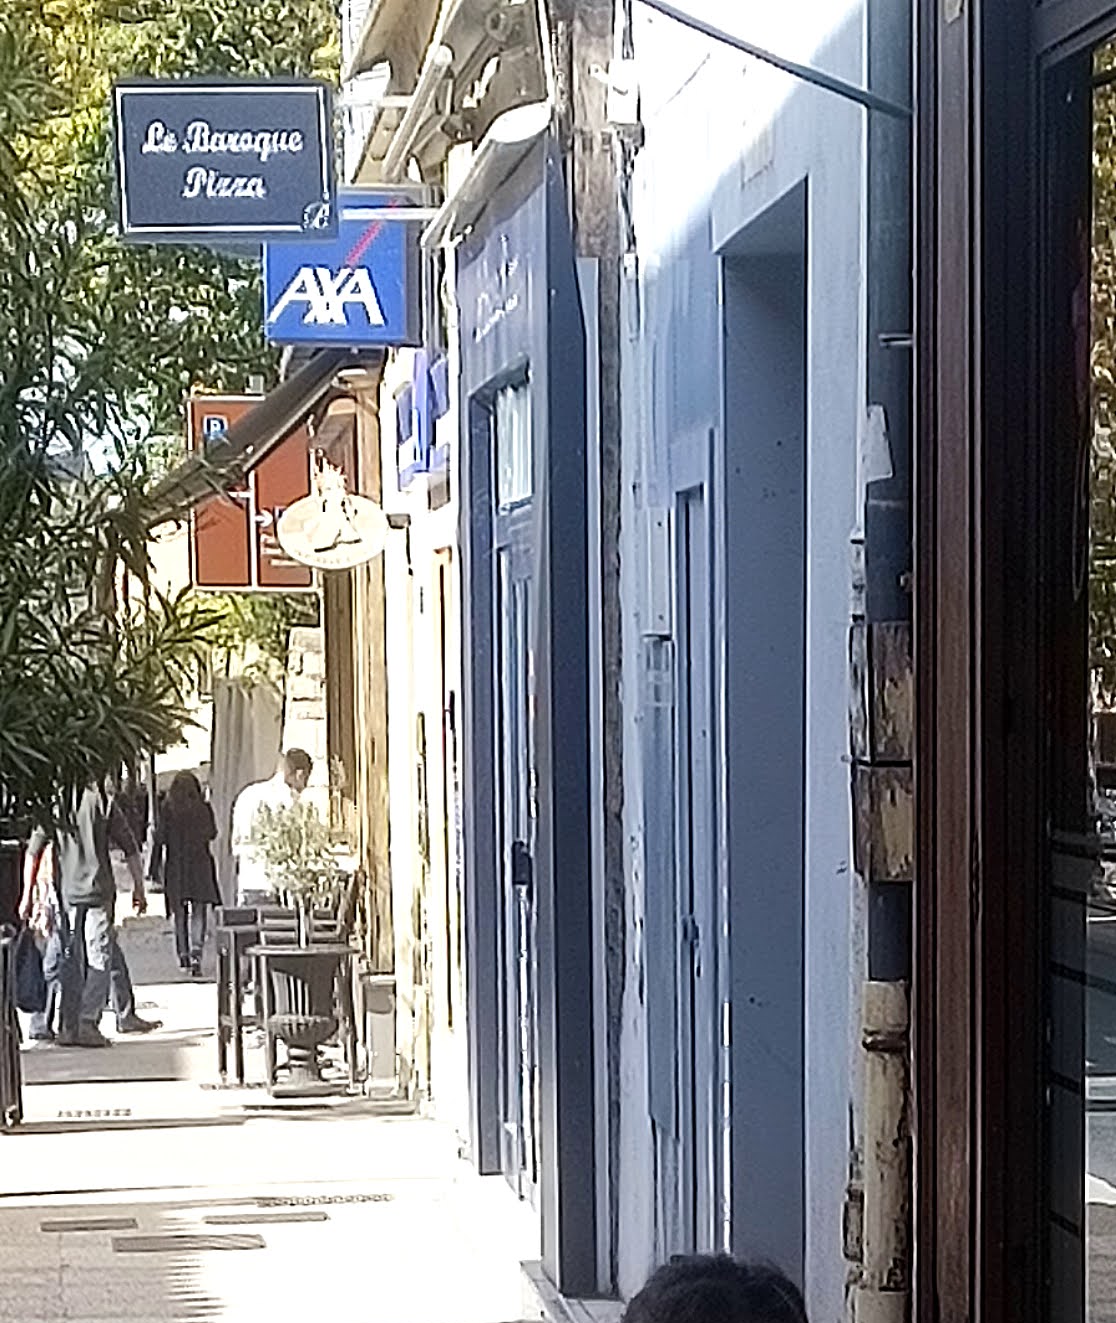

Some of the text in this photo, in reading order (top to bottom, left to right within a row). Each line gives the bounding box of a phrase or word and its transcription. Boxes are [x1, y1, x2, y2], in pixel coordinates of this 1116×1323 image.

[142, 120, 304, 161] Le Baroque
[182, 166, 267, 198] Pizza
[267, 266, 388, 326] AXA
